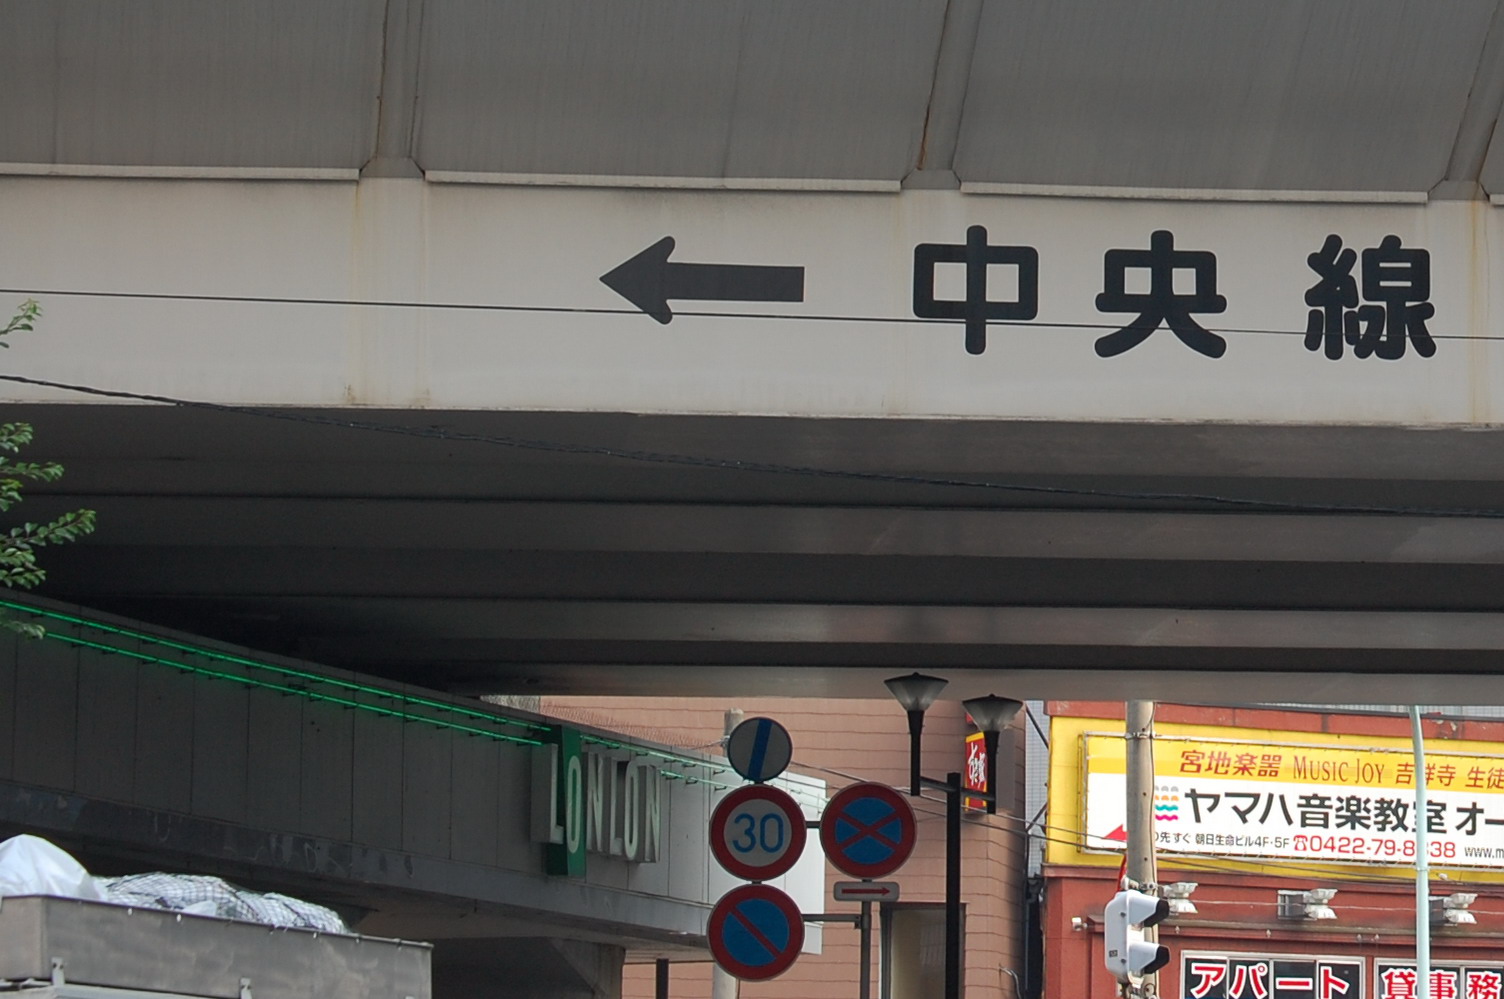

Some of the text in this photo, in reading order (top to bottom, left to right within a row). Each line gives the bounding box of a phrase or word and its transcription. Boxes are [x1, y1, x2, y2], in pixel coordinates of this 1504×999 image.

[1395, 762, 1457, 787] 吉祥寺
[1184, 787, 1447, 834] ヤマハ音楽教室
[732, 813, 785, 853] 30
[1309, 836, 1456, 858] 0422-79-838
[1191, 962, 1349, 999] アパート
